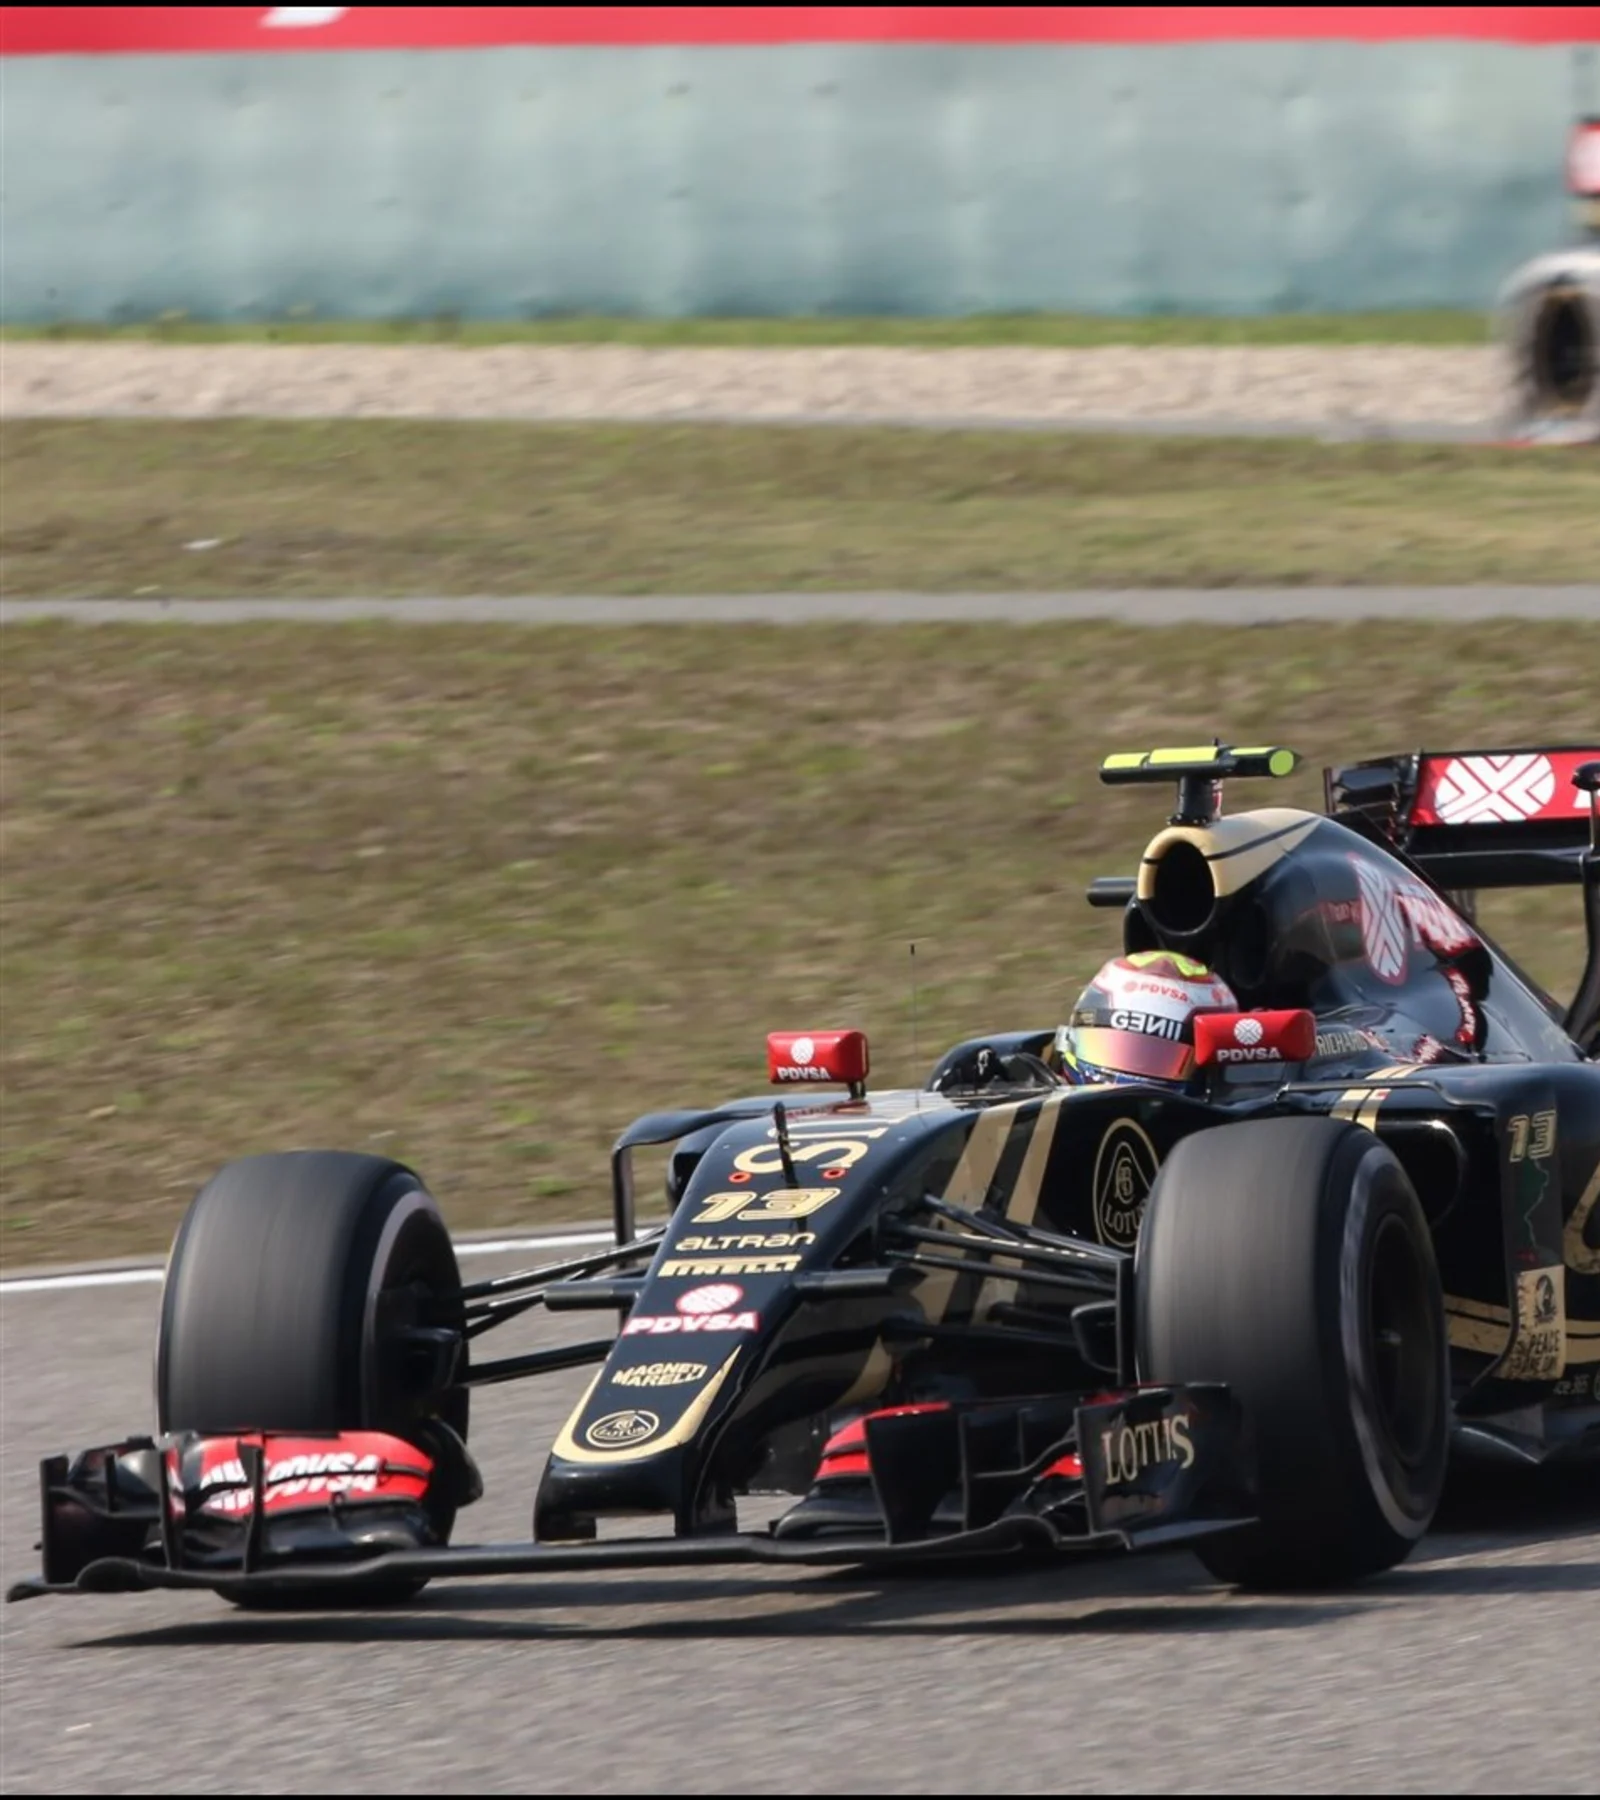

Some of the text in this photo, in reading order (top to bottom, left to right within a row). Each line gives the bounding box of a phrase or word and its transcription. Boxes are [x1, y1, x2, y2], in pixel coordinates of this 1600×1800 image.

[1139, 982, 1189, 1003] PDVSA
[1216, 1047, 1282, 1062] PDVSA
[776, 1066, 832, 1081] PDVSA
[1507, 1109, 1558, 1163] 13
[690, 1187, 842, 1223] 13
[657, 1254, 803, 1278] PIRELLI
[622, 1311, 759, 1336] PDVSA
[612, 1362, 708, 1384] MAGNETI
[1102, 1413, 1195, 1485] LOTUS
